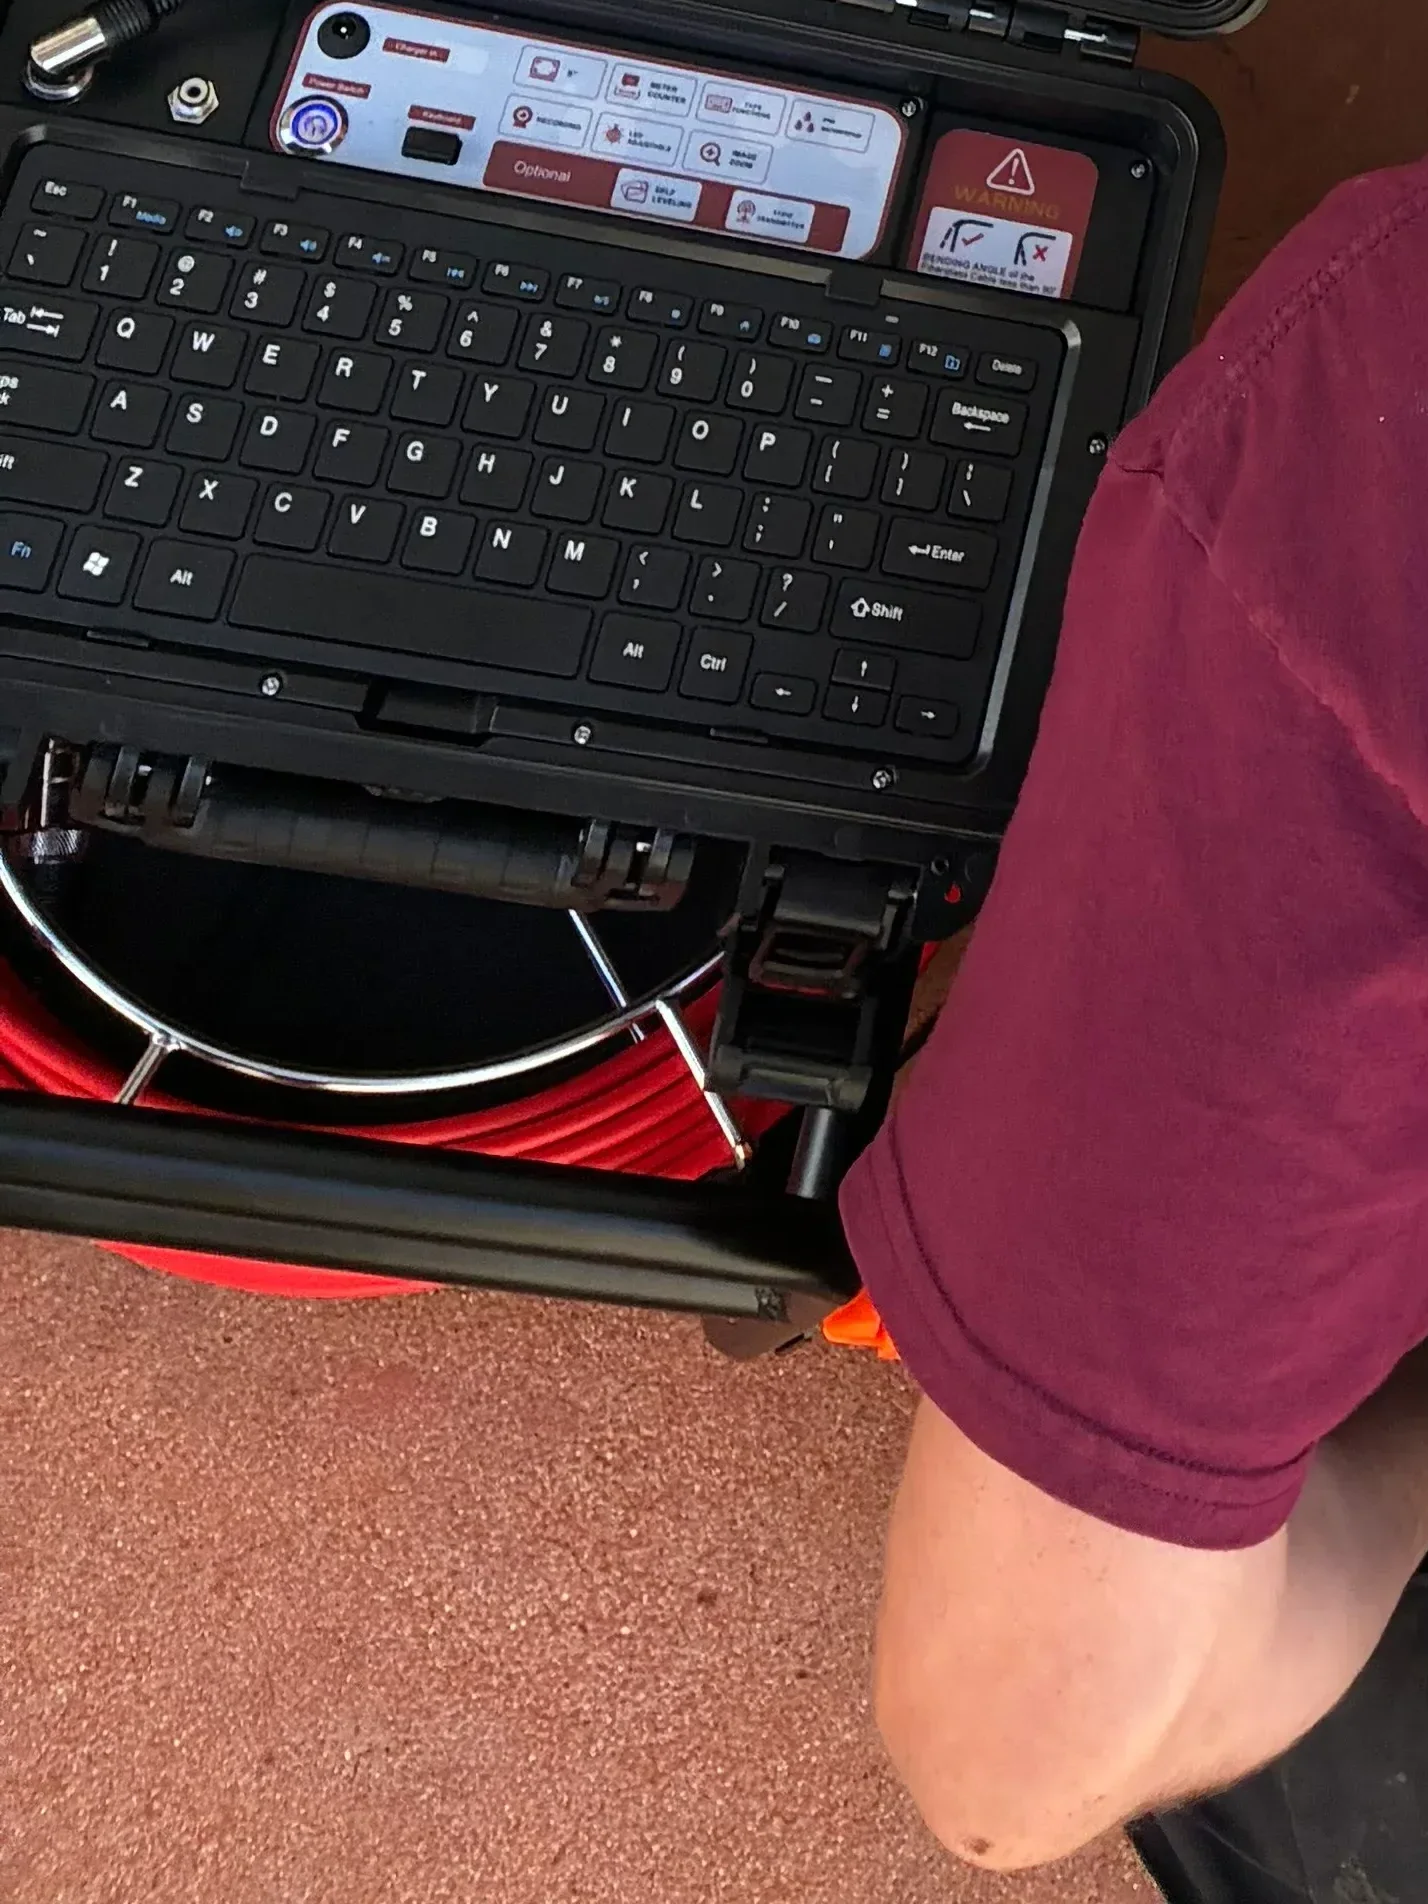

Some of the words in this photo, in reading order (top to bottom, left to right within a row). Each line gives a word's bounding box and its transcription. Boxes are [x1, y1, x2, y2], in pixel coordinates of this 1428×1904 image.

[45, 181, 67, 196] Esc
[513, 159, 572, 183] Optional
[954, 185, 1062, 220] WARNING
[2, 307, 26, 325] Tab
[116, 317, 136, 339] Q
[192, 331, 216, 352] W
[262, 344, 281, 365] E
[335, 356, 354, 378] R
[411, 369, 427, 391] T
[483, 382, 499, 403] Y
[551, 394, 569, 415] U
[622, 407, 631, 427] I
[691, 420, 710, 440] O
[759, 432, 776, 451] P
[99, 264, 110, 282] 1
[169, 278, 185, 296] 2
[243, 292, 259, 309] 3
[316, 305, 330, 322] 4
[388, 318, 403, 336] 5
[459, 330, 473, 348] 6
[534, 342, 549, 361] 7
[602, 355, 616, 373] 8
[670, 367, 683, 385] 9
[740, 380, 754, 398] 0
[951, 401, 1010, 424] Backspace
[109, 390, 128, 411] A
[186, 403, 204, 423] S
[259, 415, 279, 436] D
[332, 428, 351, 448] F
[406, 440, 425, 462] G
[477, 452, 496, 474] H
[549, 464, 565, 486] J
[619, 476, 637, 498] K
[689, 489, 704, 510] L
[930, 544, 965, 564] Enter
[124, 466, 144, 488] Z
[198, 479, 219, 500] X
[274, 492, 293, 513] C
[349, 503, 367, 525] V
[419, 516, 438, 537] B
[492, 527, 512, 550] N
[563, 540, 586, 562] M
[870, 601, 904, 622] Shift
[10, 541, 32, 559] Fn
[170, 568, 194, 586] Alt
[622, 642, 644, 659] Alt
[699, 653, 727, 673] Ctrl
